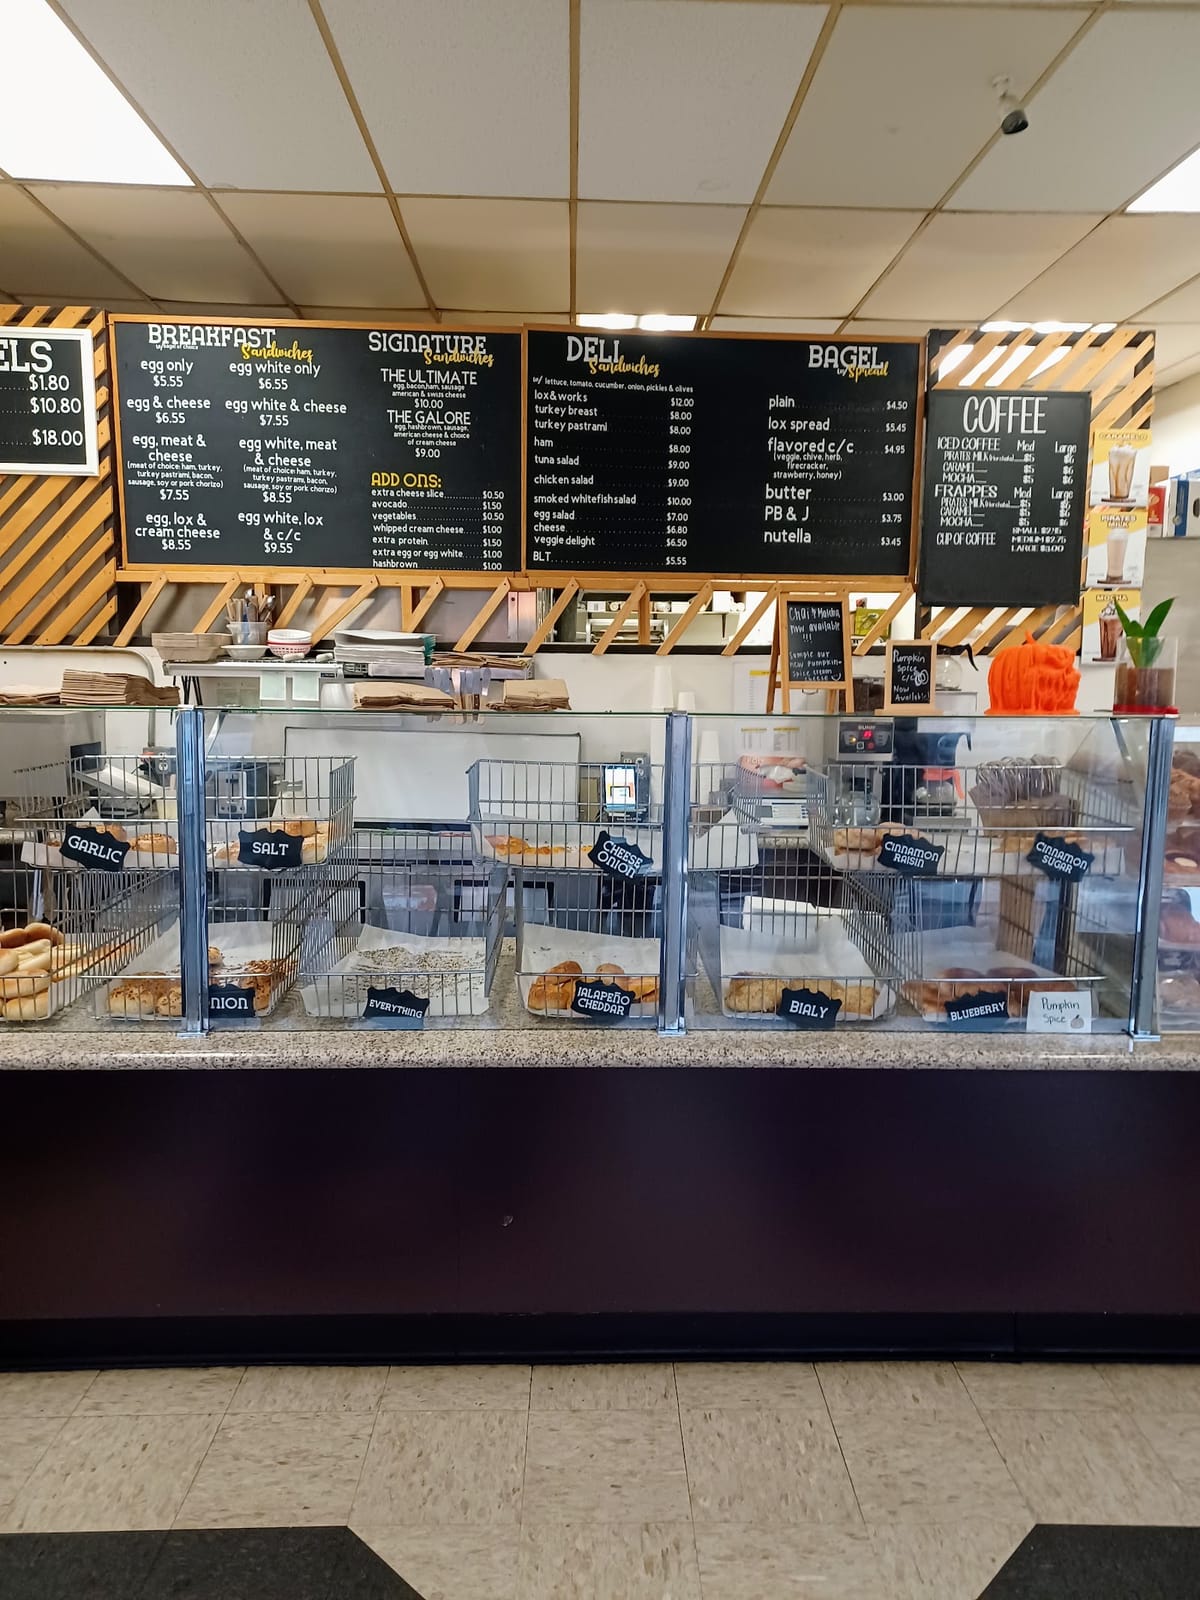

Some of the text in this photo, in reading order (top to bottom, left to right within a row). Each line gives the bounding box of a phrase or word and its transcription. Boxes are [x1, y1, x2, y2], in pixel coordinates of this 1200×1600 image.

[148, 324, 275, 348] BREAKFAST
[368, 332, 486, 354] SIGNATURE
[241, 341, 313, 363] Sandwiches
[424, 346, 494, 367] Sandwiches
[567, 336, 619, 363] DELI
[808, 345, 884, 369] BAGEL
[141, 358, 193, 374] egg only
[229, 360, 320, 377] egg white only
[589, 355, 660, 378] Sandwiches
[848, 361, 888, 383] Spread
[29, 374, 69, 391] $1.80
[153, 375, 183, 386] $5.55
[259, 378, 288, 390] $6.55
[381, 368, 477, 385] THE ULTIMATE
[30, 397, 81, 414] $10.80
[127, 396, 210, 409] egg & cheese
[225, 398, 347, 413] egg white & cheese
[415, 399, 443, 409] $10.00
[769, 395, 907, 410] plain $4.50
[156, 412, 185, 423] $6.55
[387, 410, 471, 425] THE GALORE
[535, 404, 692, 420] turkey breast $8.00
[963, 396, 1048, 434] COFFEE
[260, 415, 288, 426] $7.55
[535, 419, 691, 435] turkey pastrami $8.00
[768, 417, 906, 432] lox spread $5.45
[32, 429, 83, 446] $18.00
[161, 435, 193, 446] meat
[196, 435, 206, 446] &
[239, 439, 261, 451] egg
[306, 439, 337, 450] meat
[534, 436, 690, 453] ham $8.00
[415, 448, 440, 458] $9.00
[768, 437, 905, 454] flavored c/c $4.95
[937, 437, 1077, 454] ICED COFFEE Med Large
[149, 449, 192, 461] cheese
[255, 453, 311, 466] & cheese
[535, 455, 689, 469] tuna salad $9.00
[372, 472, 442, 488] ADD ONS:
[534, 474, 689, 487] chicken salad $9.00
[160, 488, 189, 500] $7.55
[263, 492, 292, 503] $8.55
[396, 488, 424, 497] cheese
[426, 489, 444, 498] slice
[483, 491, 504, 499] $0.50
[766, 483, 904, 501] butter $3.00
[935, 484, 998, 498] FRAPPES
[372, 500, 501, 510] avocado $1.50
[174, 513, 192, 525] lox
[197, 513, 207, 525] &
[238, 512, 260, 526] egg
[304, 512, 323, 525] lox
[372, 512, 504, 522] vegetables $0.50
[534, 510, 688, 522] egg salad $7.00
[765, 506, 902, 523] PB & J $3.75
[1101, 514, 1136, 522] PIRATES
[135, 526, 220, 538] cream cheese
[264, 528, 301, 541] & c/c
[373, 524, 408, 534] whipped
[436, 524, 464, 534] cheese
[483, 525, 502, 534] $1.00
[534, 522, 687, 534] cheese $6.80
[162, 538, 191, 550] $8.55
[764, 528, 901, 546] nutella $3.45
[937, 532, 996, 545] CUP OF COFFEE
[264, 542, 293, 553] $9.55
[397, 550, 412, 558] egg
[424, 551, 438, 559] egg
[440, 549, 463, 558] white
[483, 550, 502, 558] $1.00
[373, 560, 502, 570] hashbrown $1.00
[533, 552, 687, 565] BLT $5.55
[789, 607, 810, 620] Chai
[809, 621, 840, 632] available
[893, 649, 925, 664] Pumpkin
[898, 665, 917, 674] Spice
[68, 835, 122, 863] GARLIC
[252, 842, 288, 856] SALT
[602, 840, 643, 869] CHEESE
[884, 841, 939, 862] CINNAMON
[1035, 841, 1088, 871] CINNAMON
[597, 850, 636, 880] ONION
[893, 853, 925, 868] RAISIN
[1041, 854, 1073, 874] SUGAR
[208, 997, 249, 1010] NION
[577, 986, 630, 1006] JALAPEÑO
[369, 1000, 423, 1019] EVERYTHING
[577, 998, 625, 1016] CHEDDAR
[789, 1000, 829, 1019] BIALY
[950, 1000, 1007, 1022] BLUEBERRY
[1042, 997, 1080, 1013] Pumpkin
[1043, 1014, 1066, 1024] Spice
